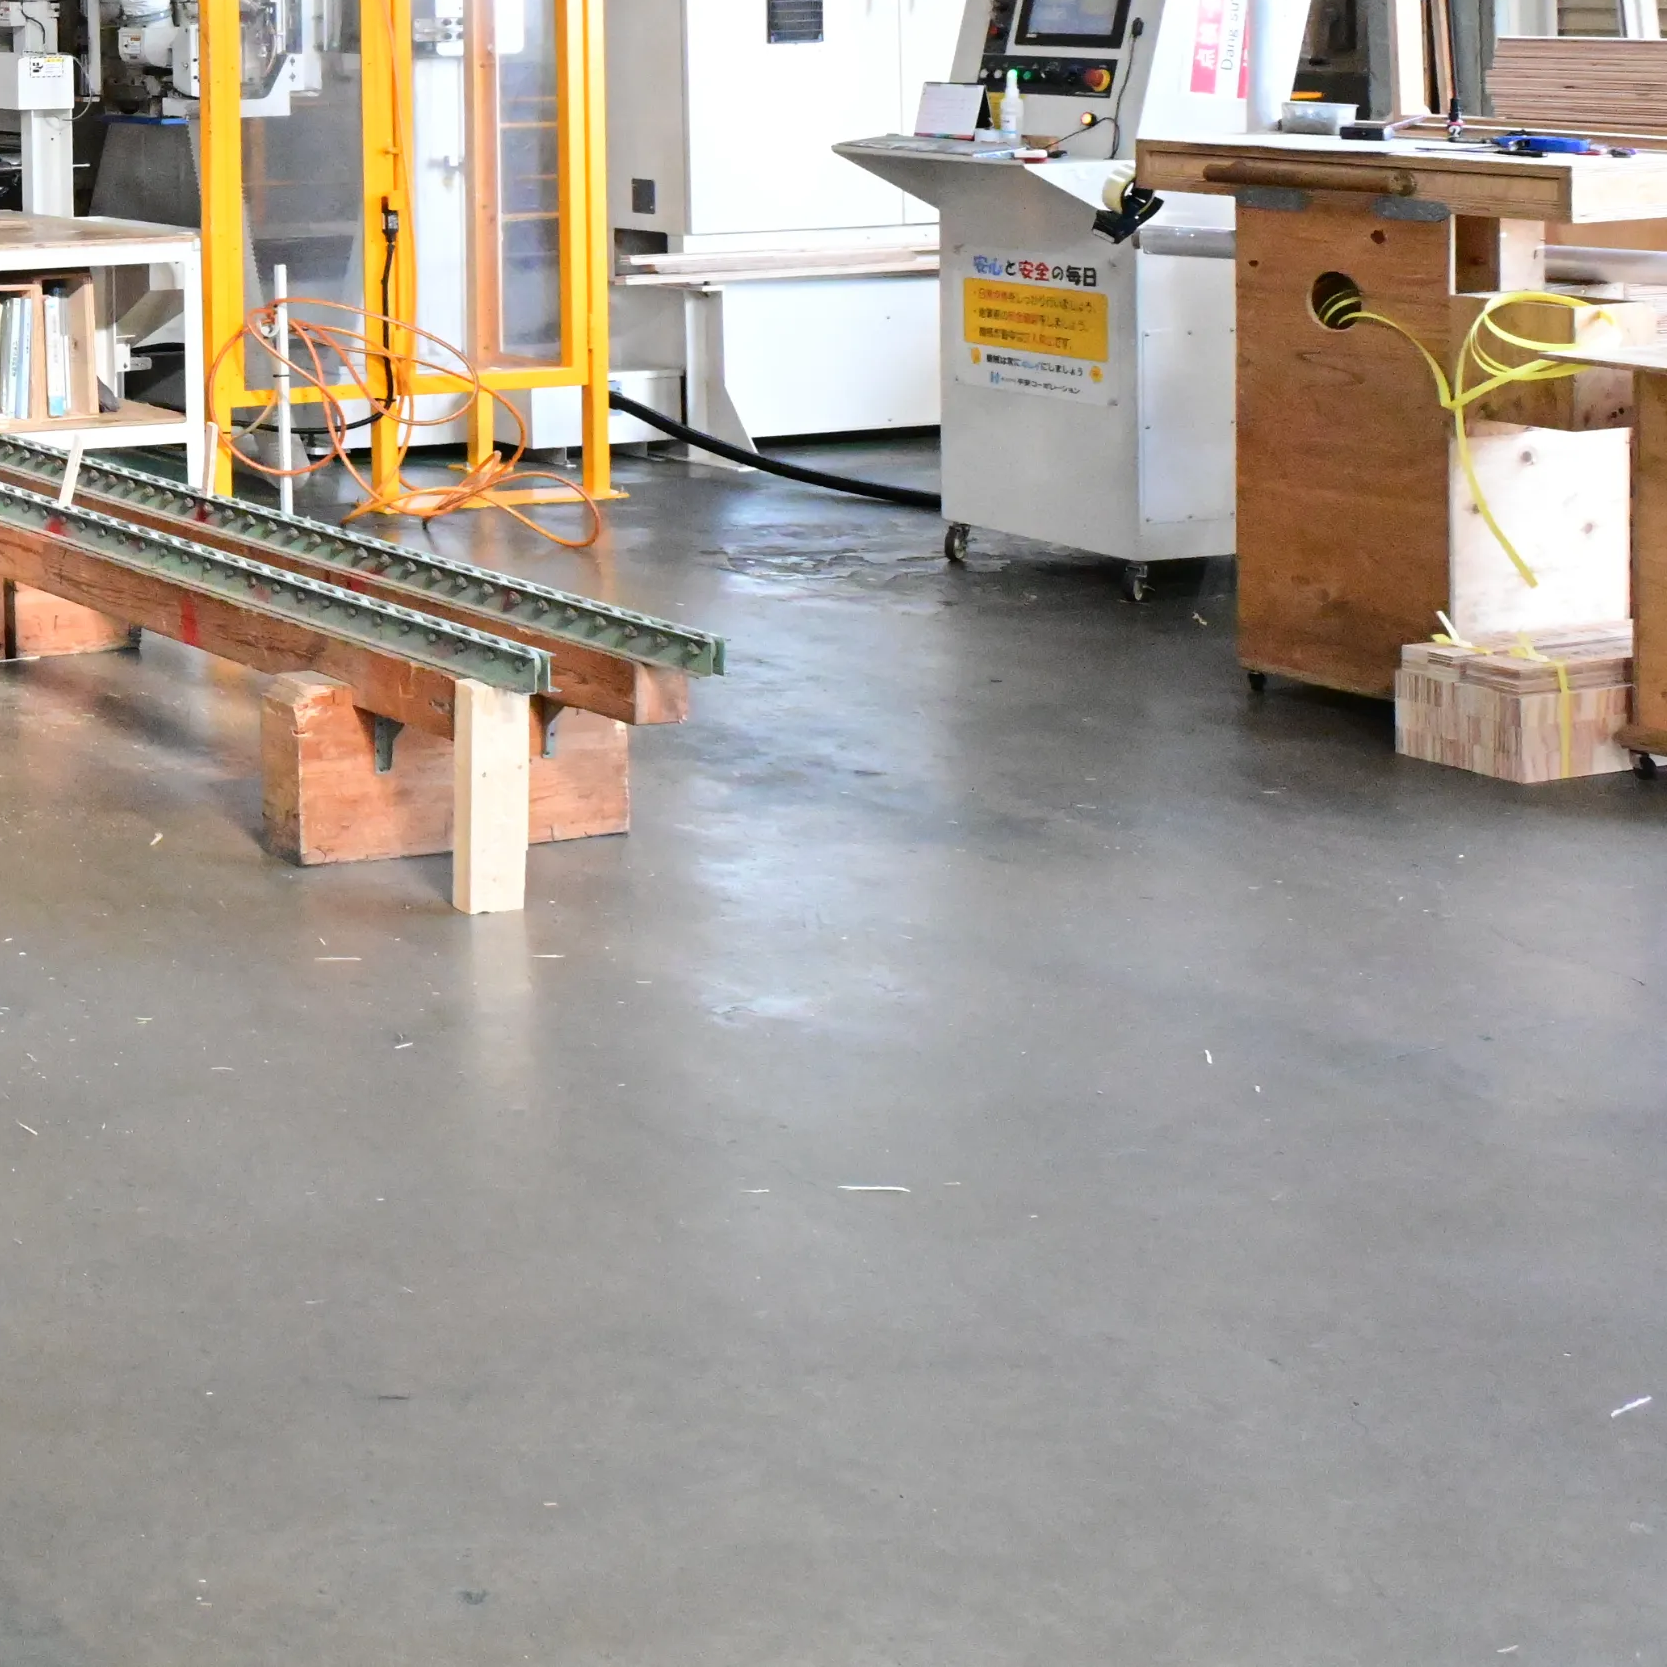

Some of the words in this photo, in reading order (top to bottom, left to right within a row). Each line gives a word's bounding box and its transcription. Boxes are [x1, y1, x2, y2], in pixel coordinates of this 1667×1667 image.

[973, 254, 1097, 287] 安心と安全の毎日
